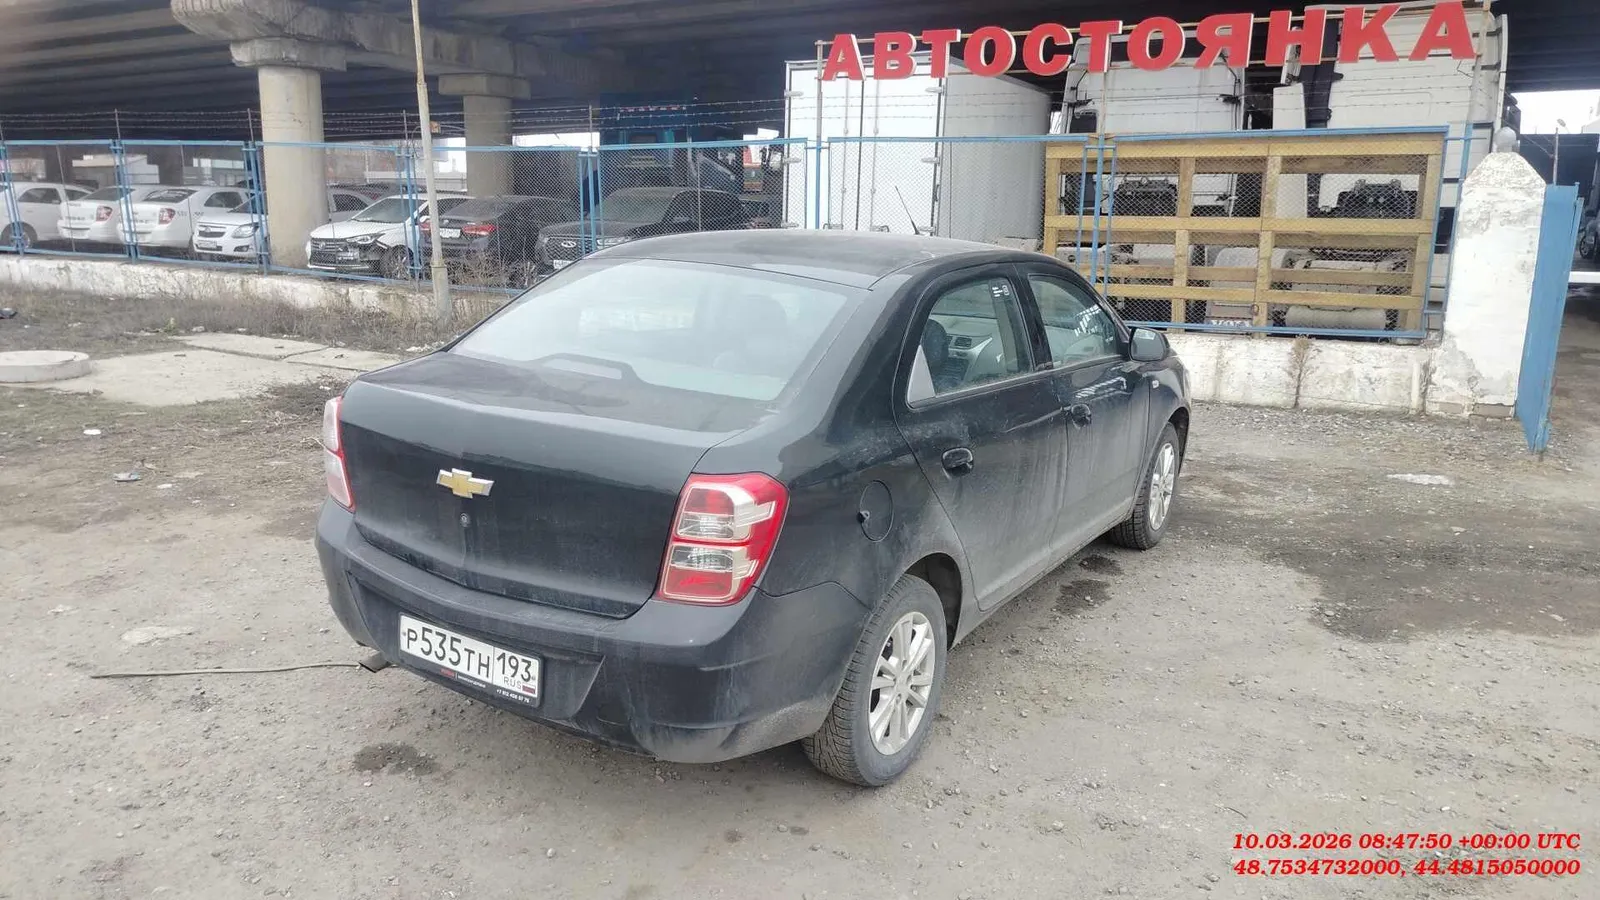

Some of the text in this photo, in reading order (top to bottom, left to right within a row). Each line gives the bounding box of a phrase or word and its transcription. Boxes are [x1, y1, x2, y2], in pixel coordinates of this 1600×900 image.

[822, 1, 1477, 81] АВТОСТОЯНКА
[406, 626, 532, 682] Р535ТН 193
[503, 676, 522, 690] RUS
